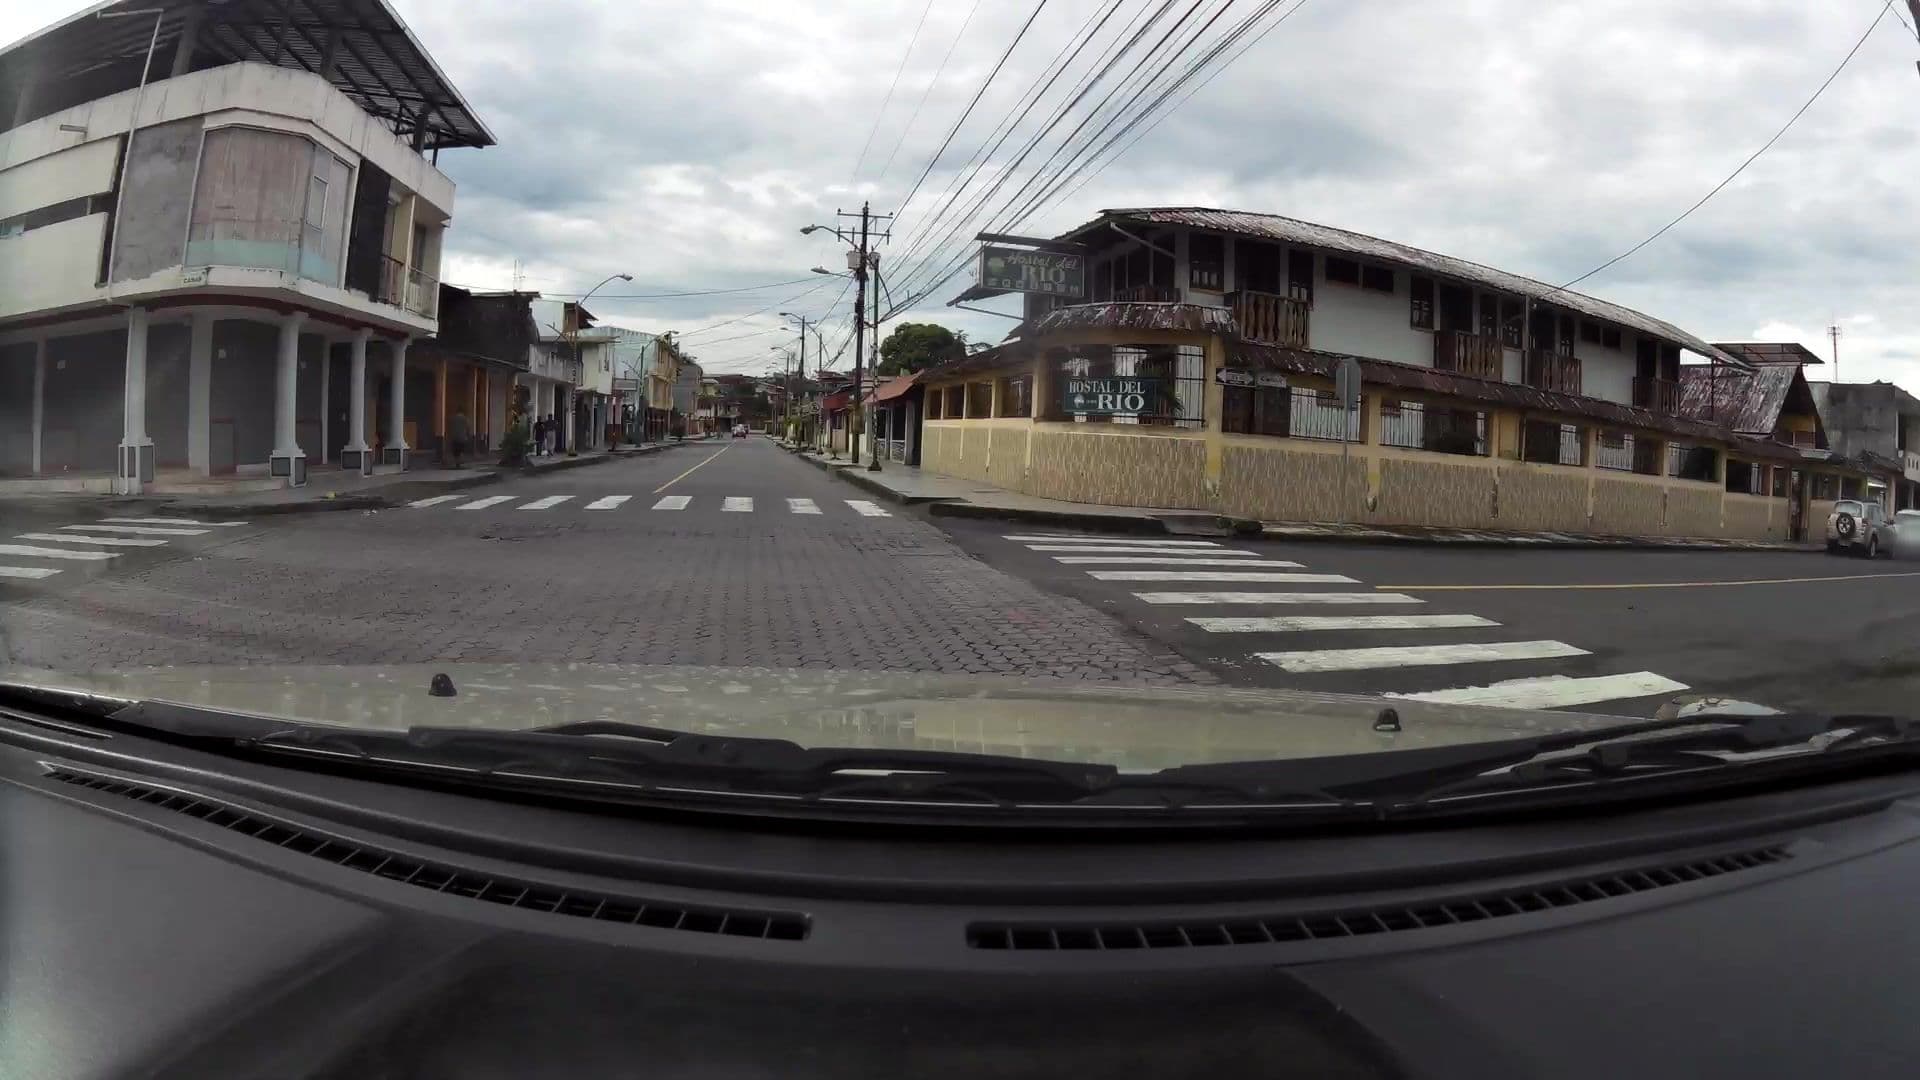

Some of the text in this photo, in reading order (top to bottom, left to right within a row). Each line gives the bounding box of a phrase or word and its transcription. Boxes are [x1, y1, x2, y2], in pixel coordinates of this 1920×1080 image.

[1069, 380, 1146, 394] HOSTAL DEL
[1097, 393, 1145, 410] RIO
